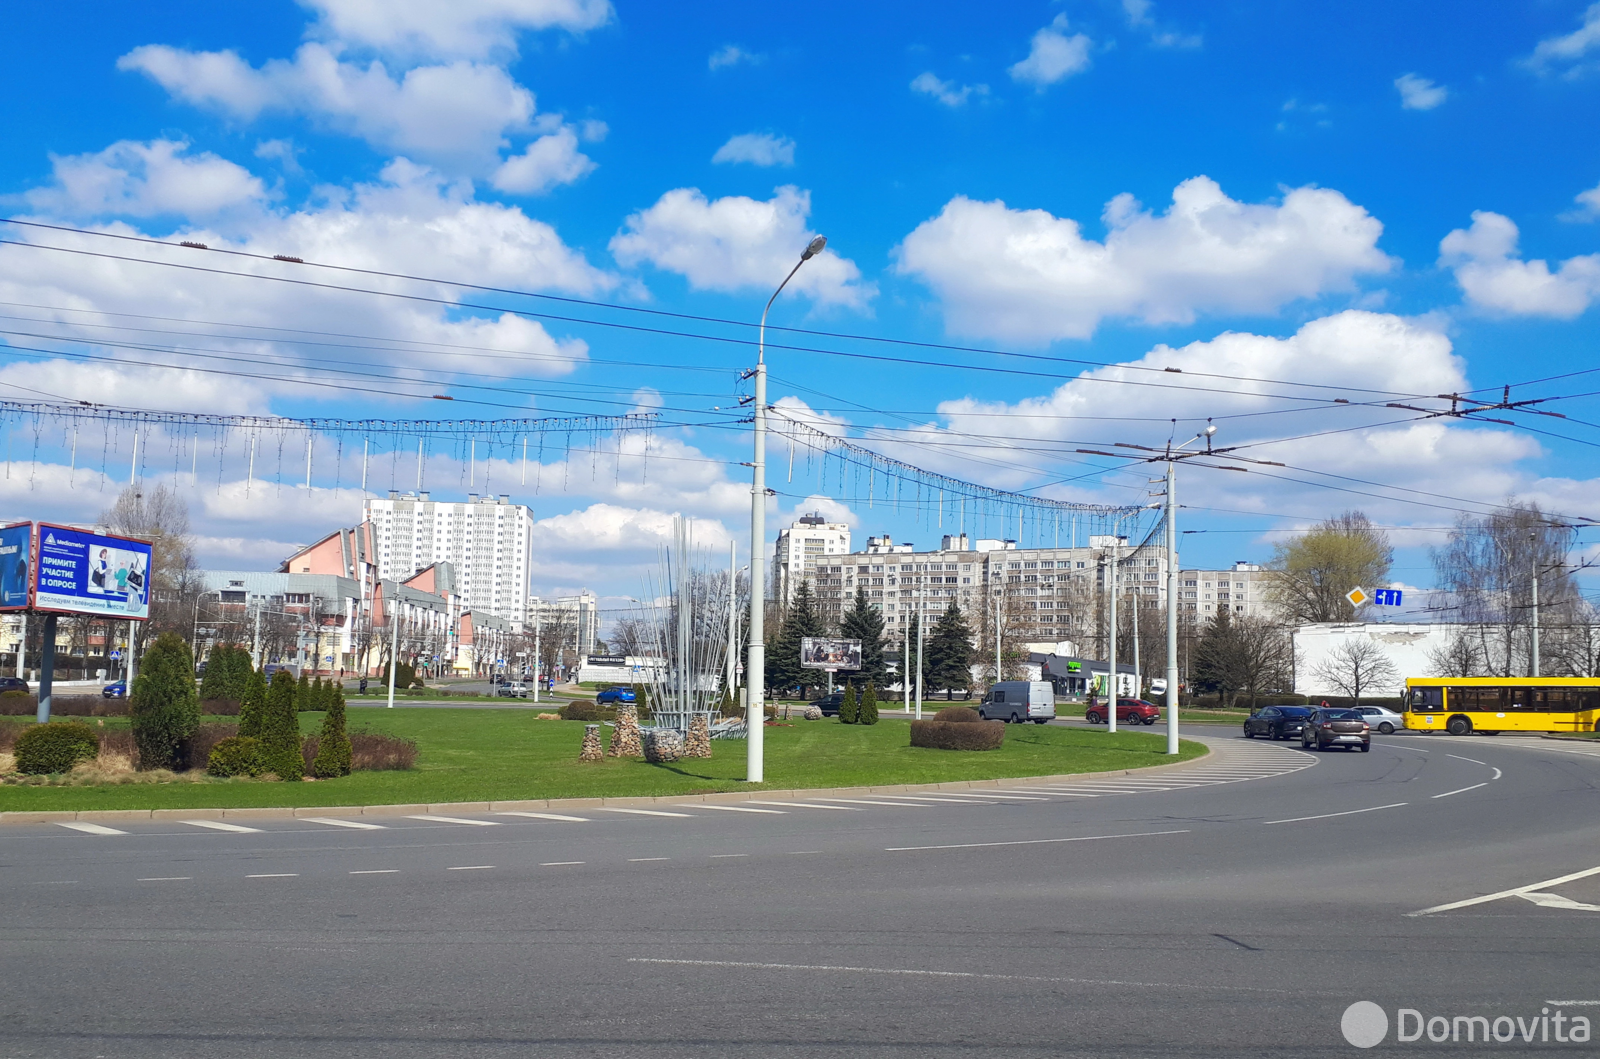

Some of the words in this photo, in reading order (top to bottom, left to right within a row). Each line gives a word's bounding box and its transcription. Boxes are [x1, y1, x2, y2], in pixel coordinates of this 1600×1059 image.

[43, 556, 76, 568] ПРИМИТЕ
[42, 567, 74, 578] УЧАСТИЕ
[47, 579, 76, 589] ОПРОСЕ
[39, 596, 71, 604] Исследуем
[72, 600, 105, 608] телевидение
